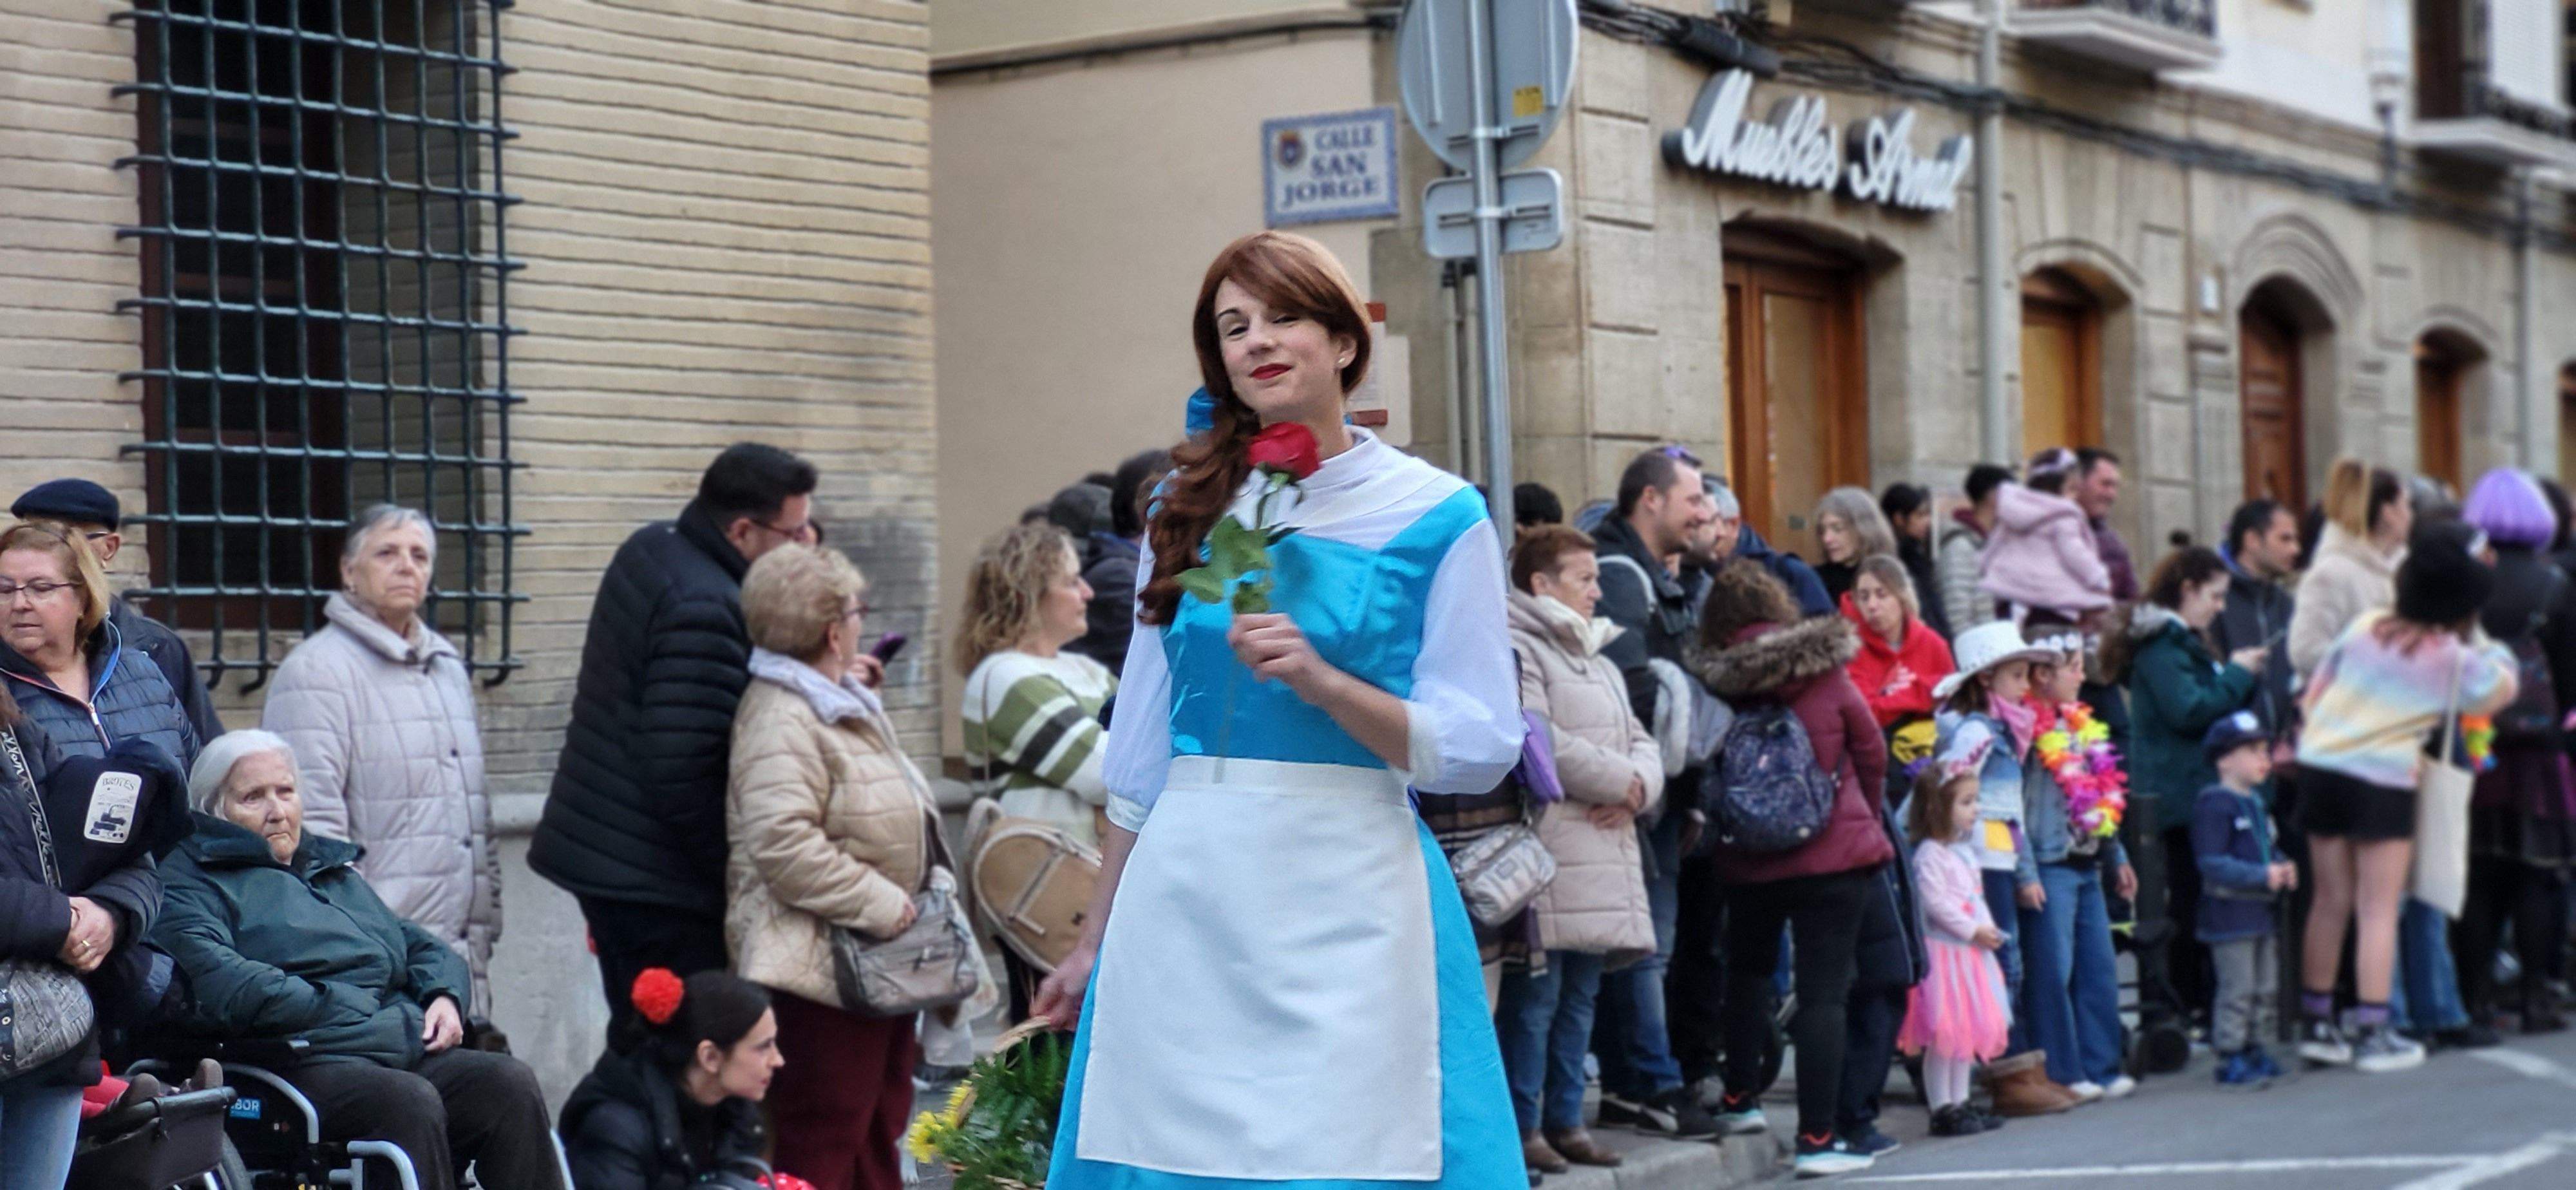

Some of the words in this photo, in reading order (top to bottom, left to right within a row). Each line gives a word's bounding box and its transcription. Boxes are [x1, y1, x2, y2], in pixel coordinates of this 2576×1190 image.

[1315, 125, 1374, 151] CALLE
[1681, 67, 1840, 193] Muebles
[1849, 108, 1974, 213] Arnal
[1311, 151, 1367, 178] SAN
[1282, 176, 1379, 207] JORGE
[231, 1098, 259, 1111] BOR
